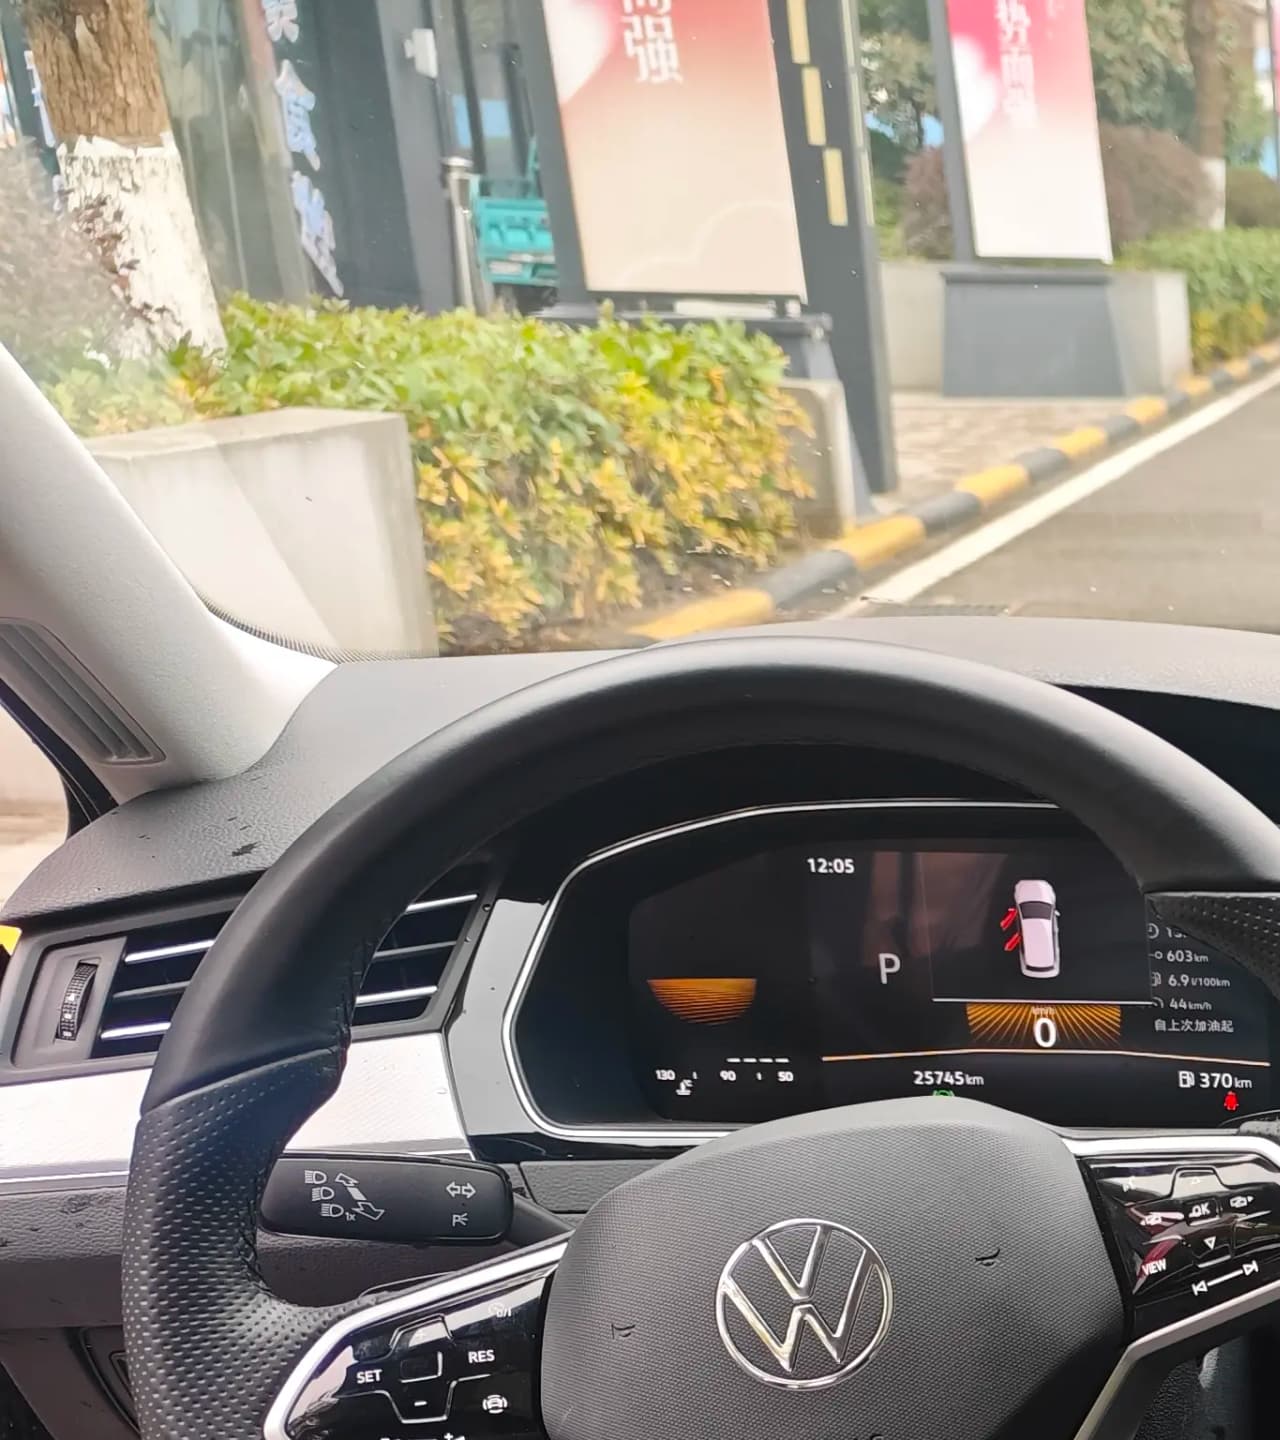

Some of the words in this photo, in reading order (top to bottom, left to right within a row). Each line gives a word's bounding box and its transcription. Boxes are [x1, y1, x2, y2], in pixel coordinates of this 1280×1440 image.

[807, 857, 855, 874] 12:05
[878, 952, 901, 985] P
[1033, 1016, 1058, 1048] 0
[1154, 1018, 1234, 1033] 自上次加油起
[655, 1069, 676, 1081] 130
[719, 1070, 737, 1082] 90
[777, 1071, 794, 1082] 50
[1141, 1258, 1168, 1276] VIEW
[468, 1349, 496, 1365] RES
[356, 1368, 383, 1384] SET
